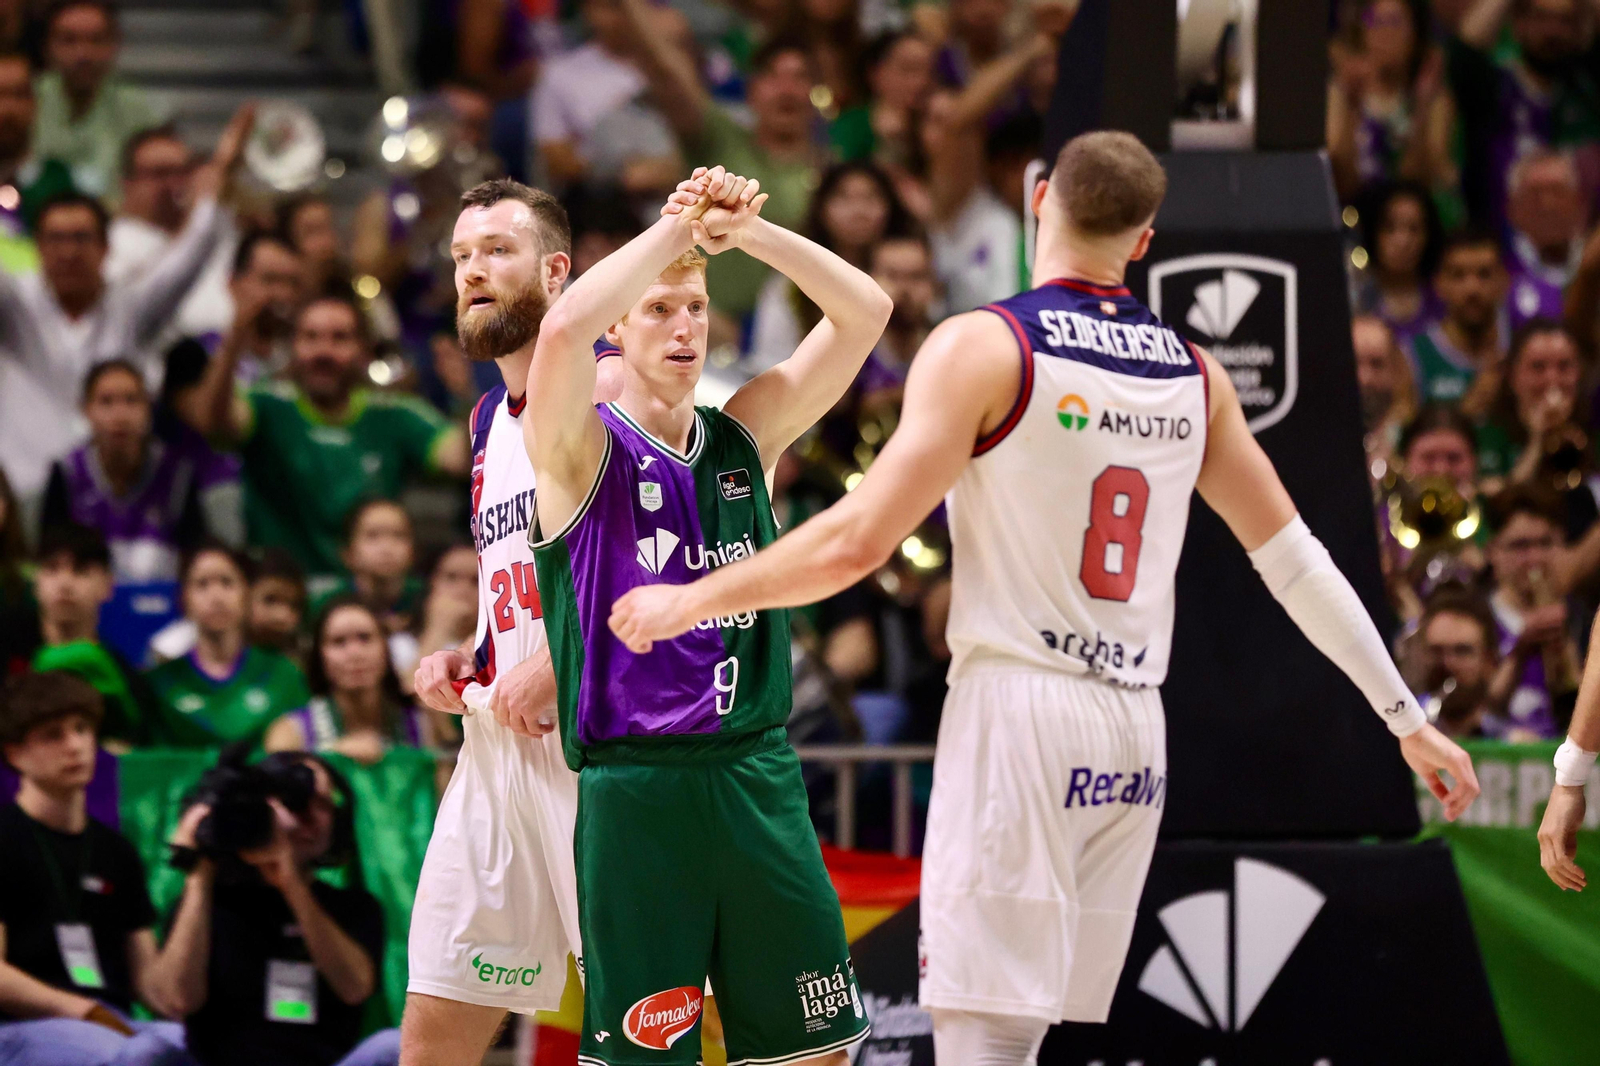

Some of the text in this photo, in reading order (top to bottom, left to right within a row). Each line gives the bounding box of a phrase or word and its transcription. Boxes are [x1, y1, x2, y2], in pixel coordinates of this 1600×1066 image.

[1038, 309, 1192, 367] SEDEKERSKIS
[1099, 409, 1192, 440] AMUTIO
[685, 533, 757, 570] Unicaj
[1079, 464, 1150, 602] 8
[490, 561, 544, 633] 24
[714, 656, 739, 716] 9
[795, 970, 820, 983] sabor
[797, 984, 806, 993] a
[806, 964, 848, 999] má
[800, 991, 852, 1019] laga
